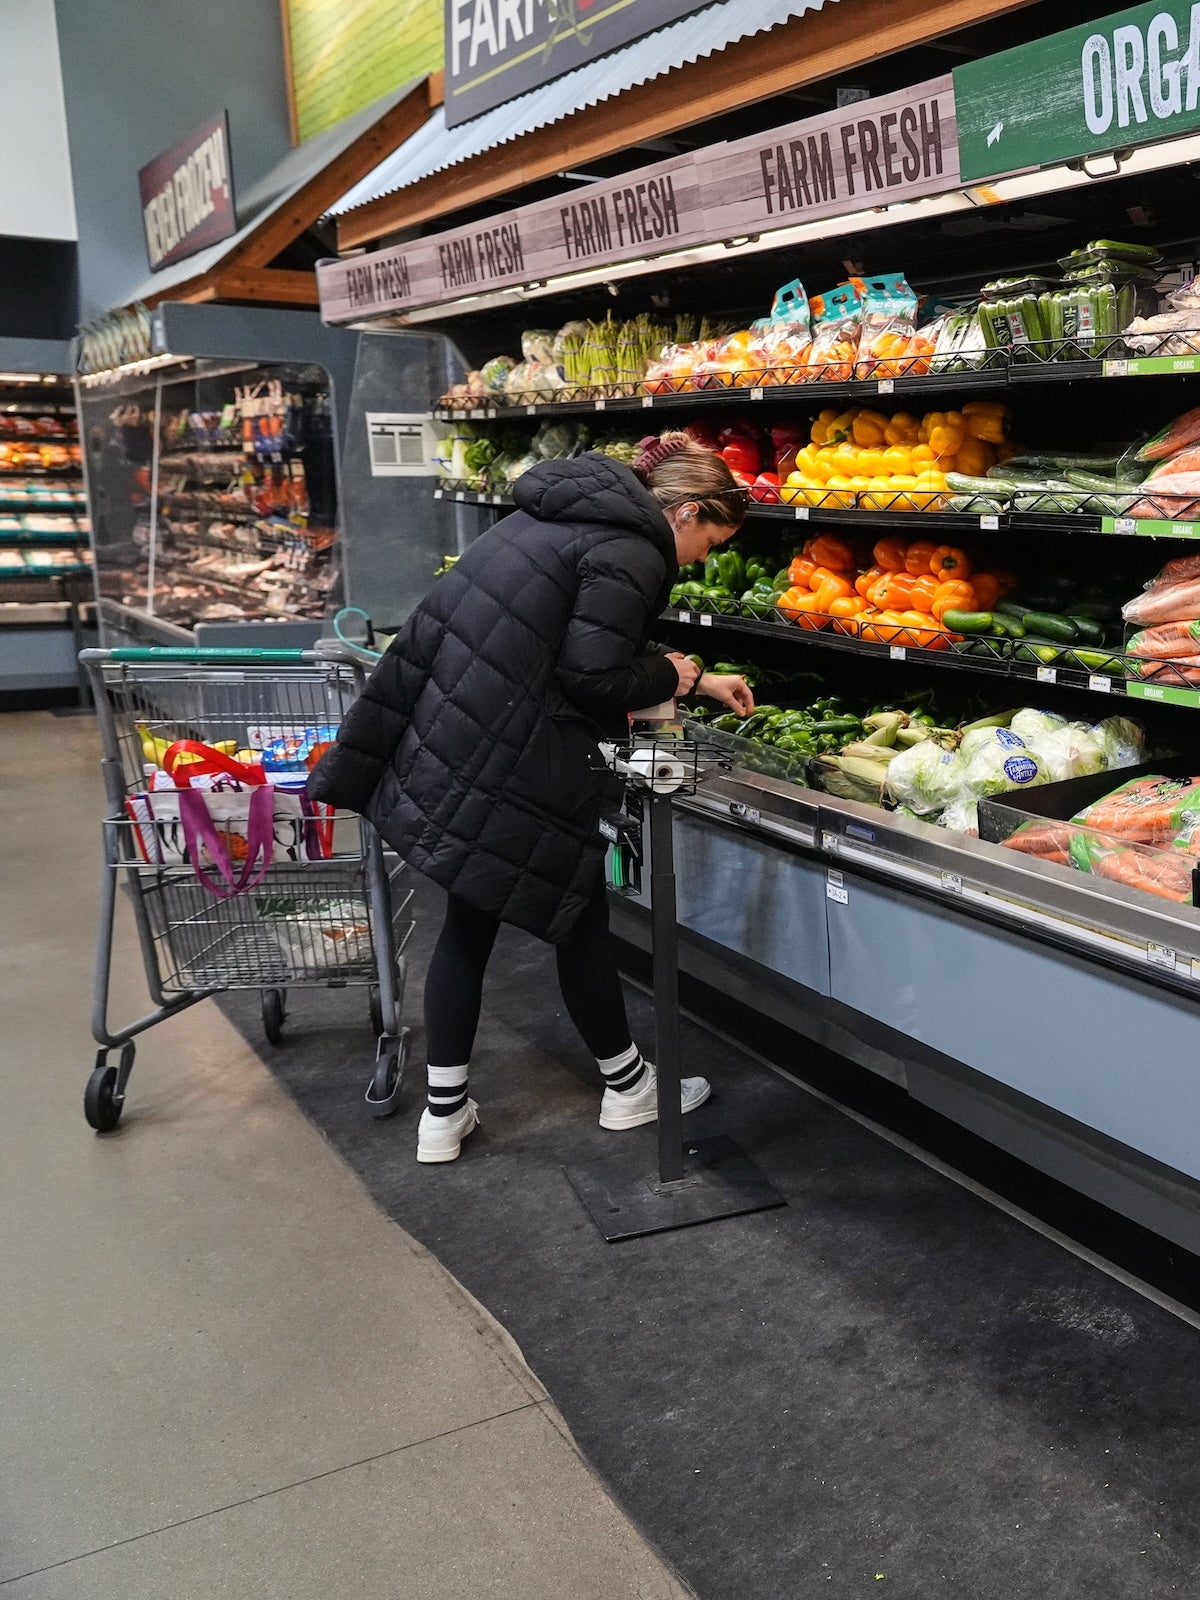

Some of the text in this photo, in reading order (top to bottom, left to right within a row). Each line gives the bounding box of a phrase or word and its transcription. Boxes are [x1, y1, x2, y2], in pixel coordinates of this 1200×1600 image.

[760, 100, 943, 214] FARM FRESH
[560, 176, 679, 260] FARM FRESH
[347, 256, 411, 308] FARM FRESH
[439, 223, 524, 288] FARM FRESH
[1172, 524, 1194, 535] ORGANIC
[1144, 687, 1165, 699] ORGANIC
